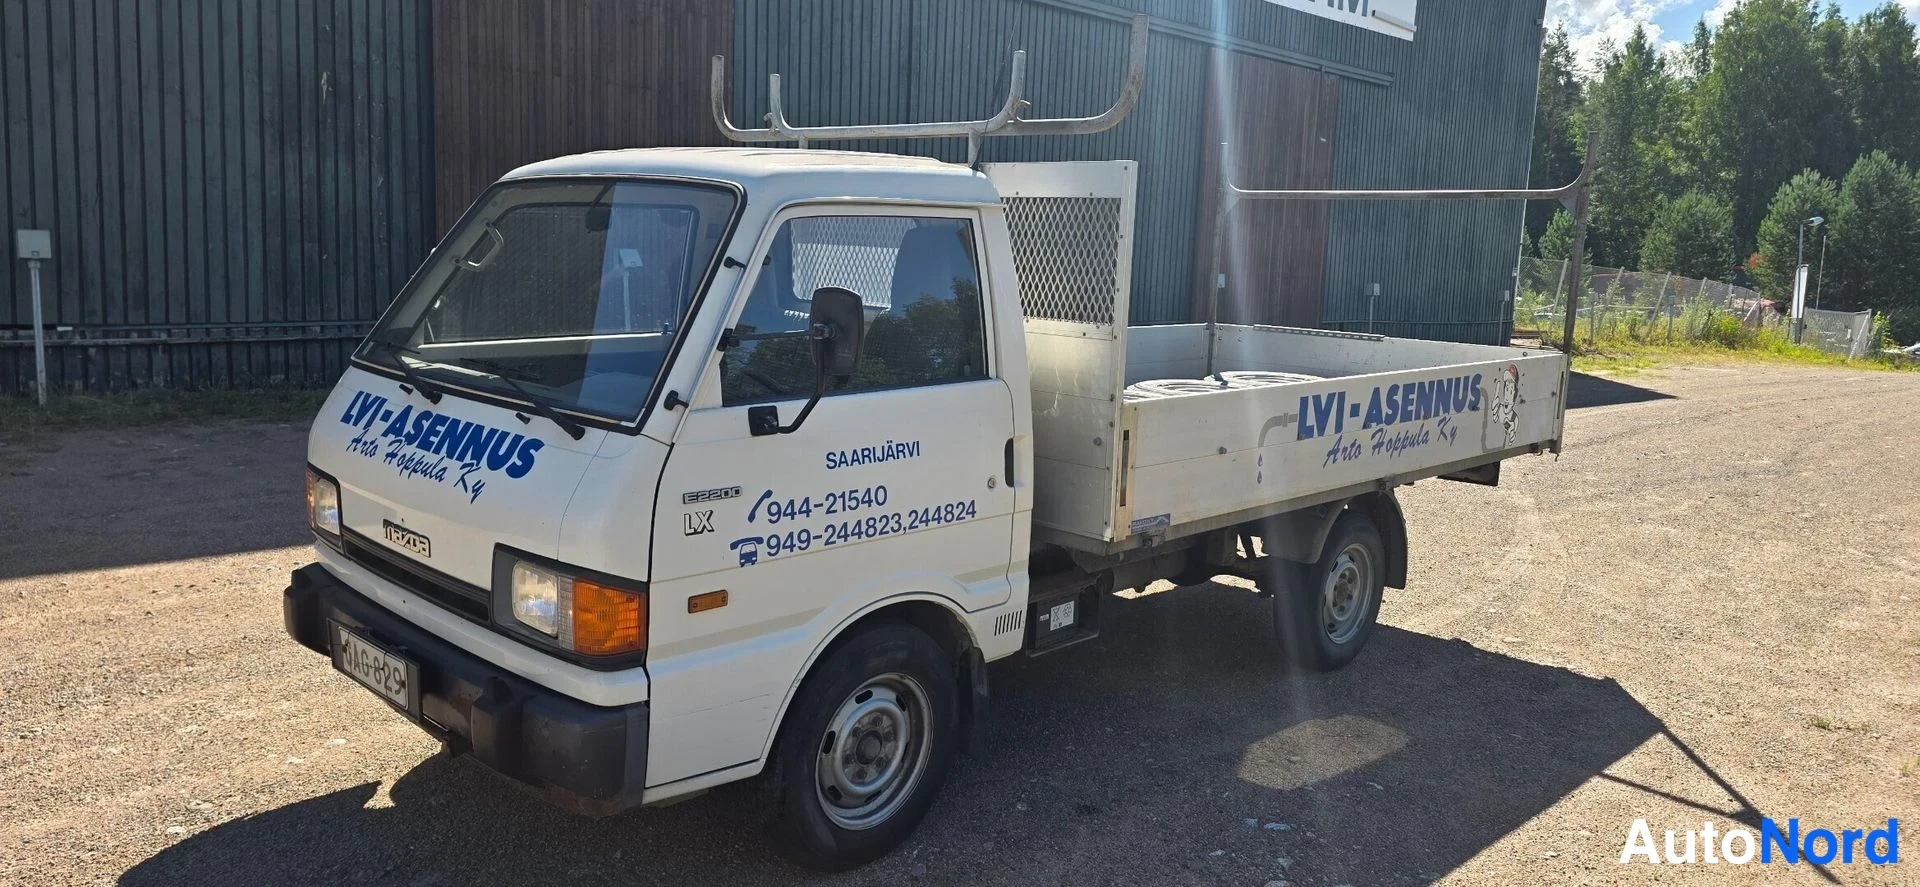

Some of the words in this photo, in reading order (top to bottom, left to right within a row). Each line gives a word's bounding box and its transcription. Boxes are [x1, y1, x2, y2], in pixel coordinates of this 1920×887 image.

[1297, 373, 1482, 441] LVI-ASENNUS
[340, 390, 545, 479] LVI-ASENNUS
[825, 440, 920, 470] SAARIJÄRVI
[1323, 435, 1362, 469] Arto
[1371, 423, 1430, 459] Hoppula
[1437, 416, 1458, 447] Ky
[346, 428, 379, 459] Arto
[383, 437, 447, 483] Hoppula
[454, 461, 486, 504] Ky
[682, 486, 742, 504] E2200
[767, 485, 888, 524] 944-21540
[684, 510, 714, 536] LX
